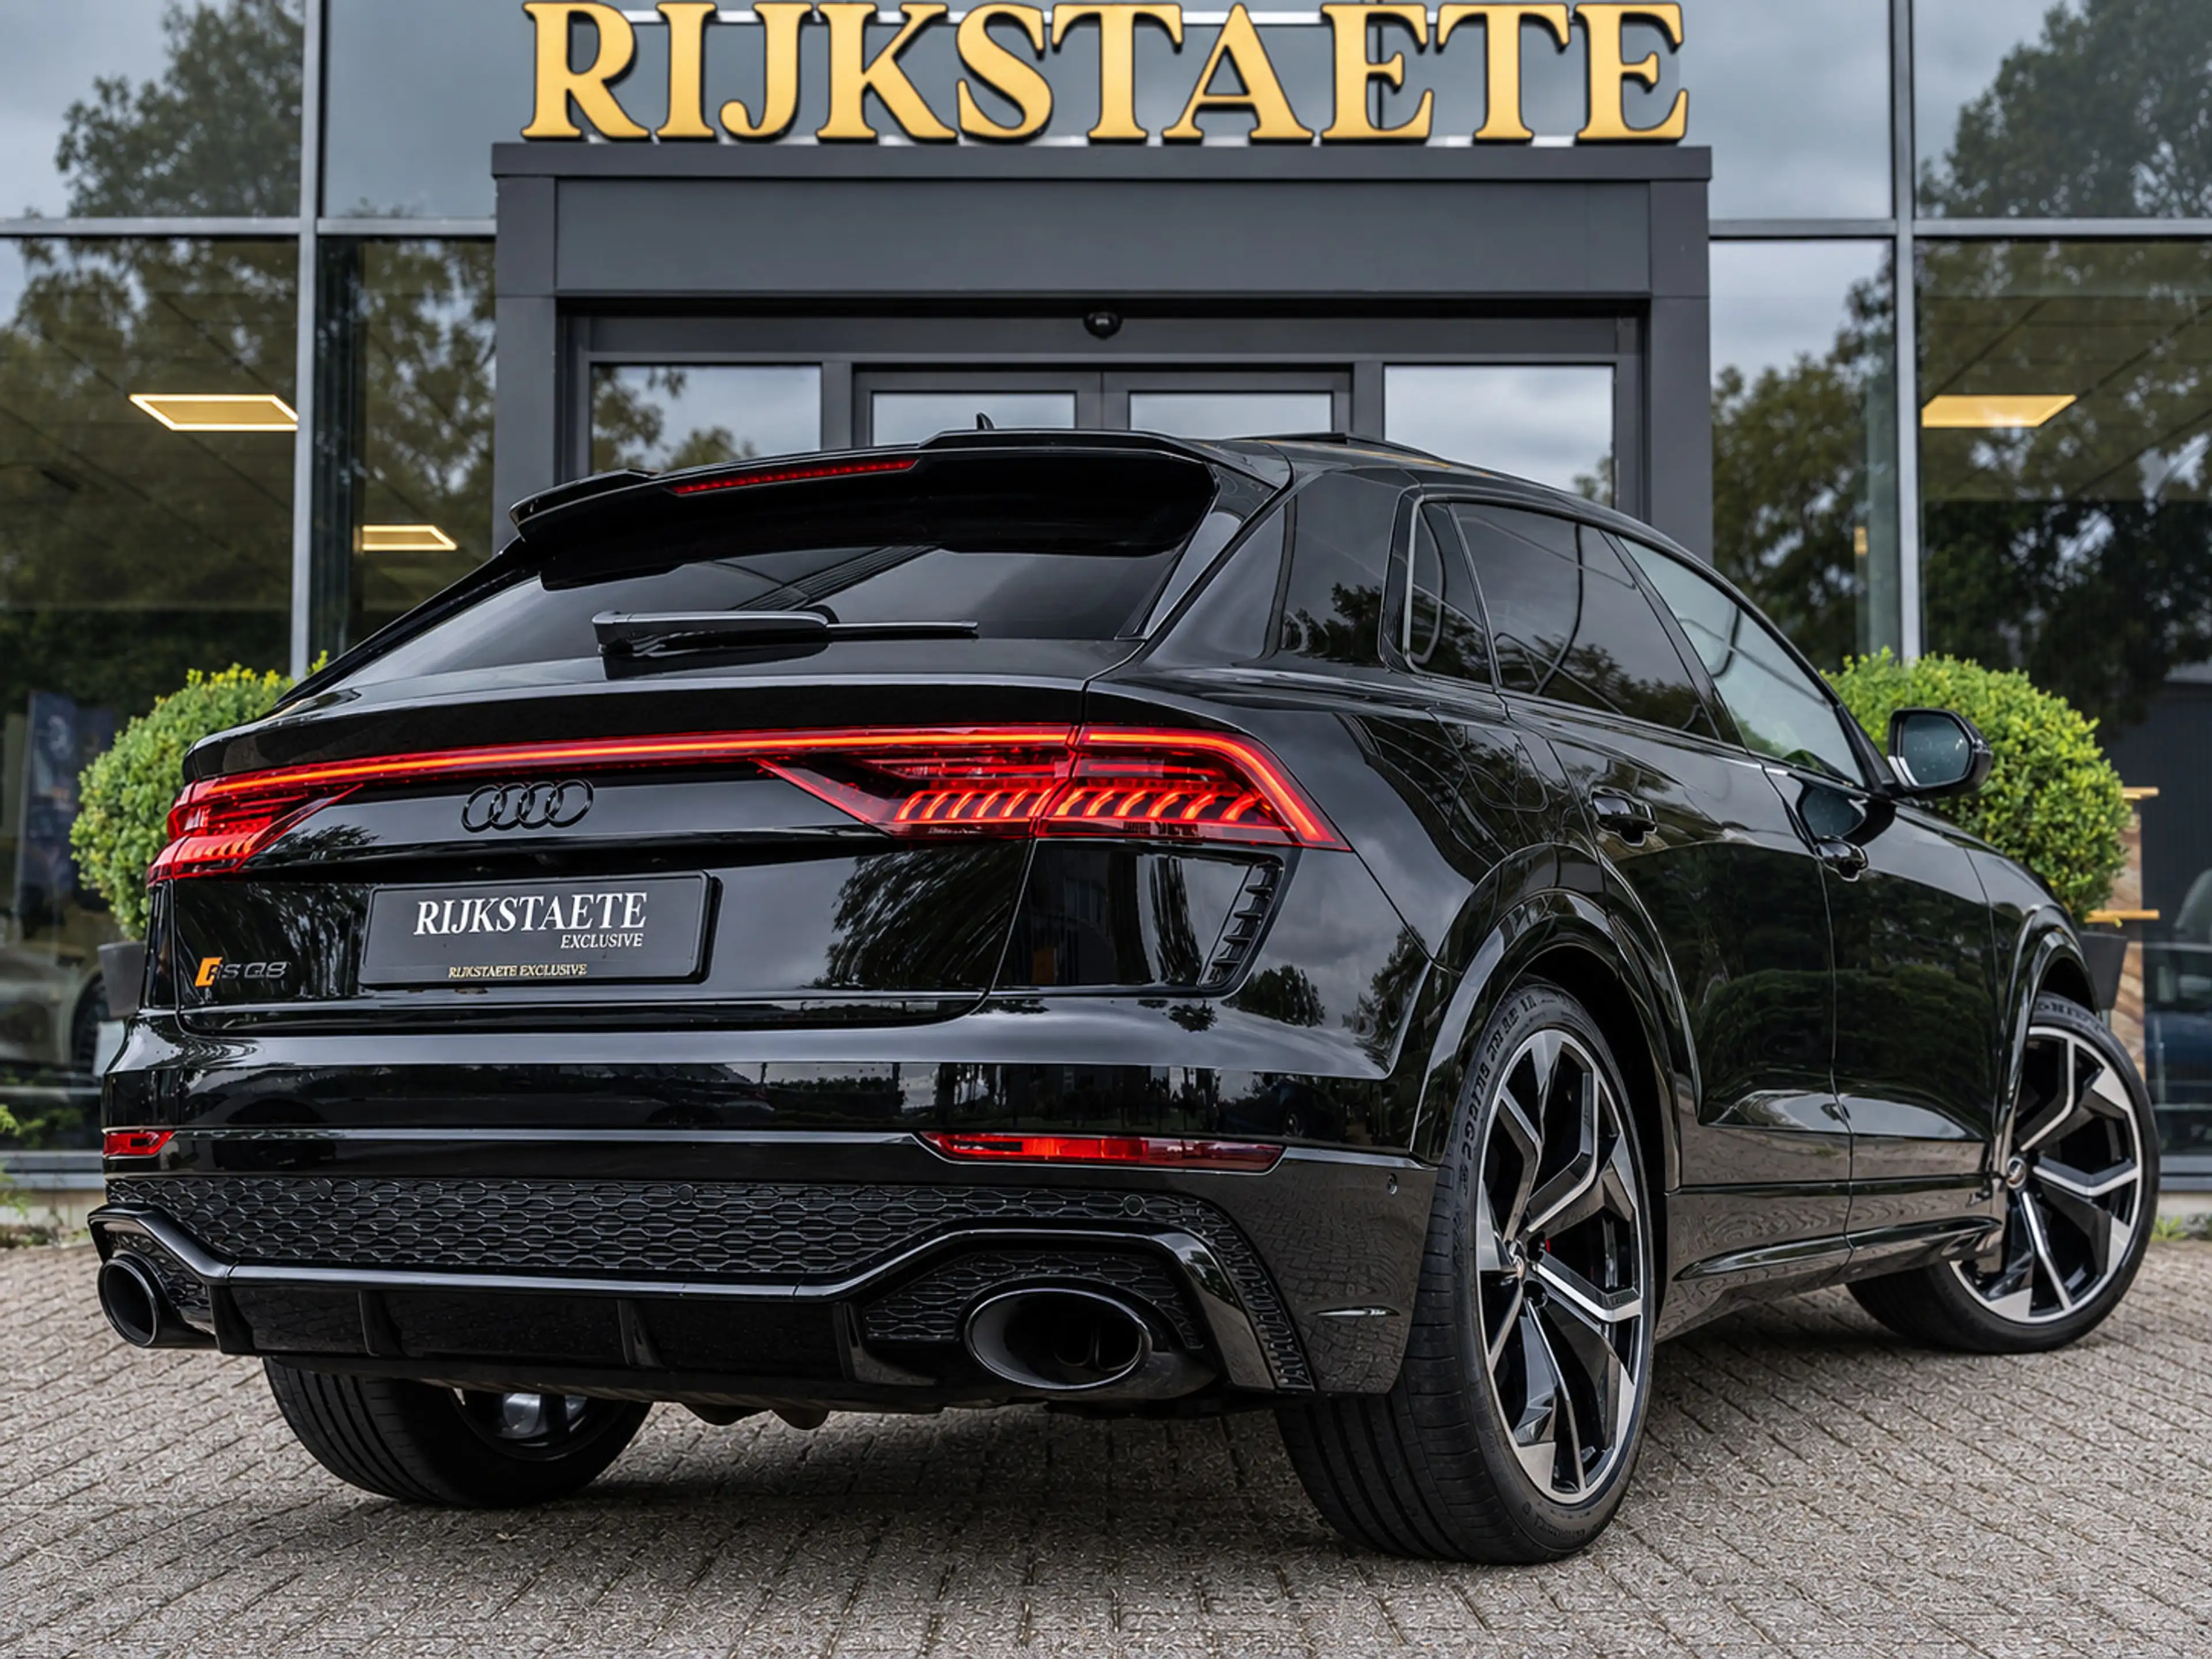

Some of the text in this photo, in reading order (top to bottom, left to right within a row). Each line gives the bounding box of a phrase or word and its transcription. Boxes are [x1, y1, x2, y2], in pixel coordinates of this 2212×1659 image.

[521, 1, 1689, 143] RIJKSTAETE
[413, 892, 647, 936] RIJKSTAETE
[560, 933, 644, 949] EXCLUSIVE
[448, 963, 588, 979] RIJKSTAETE EXCLUSIVE
